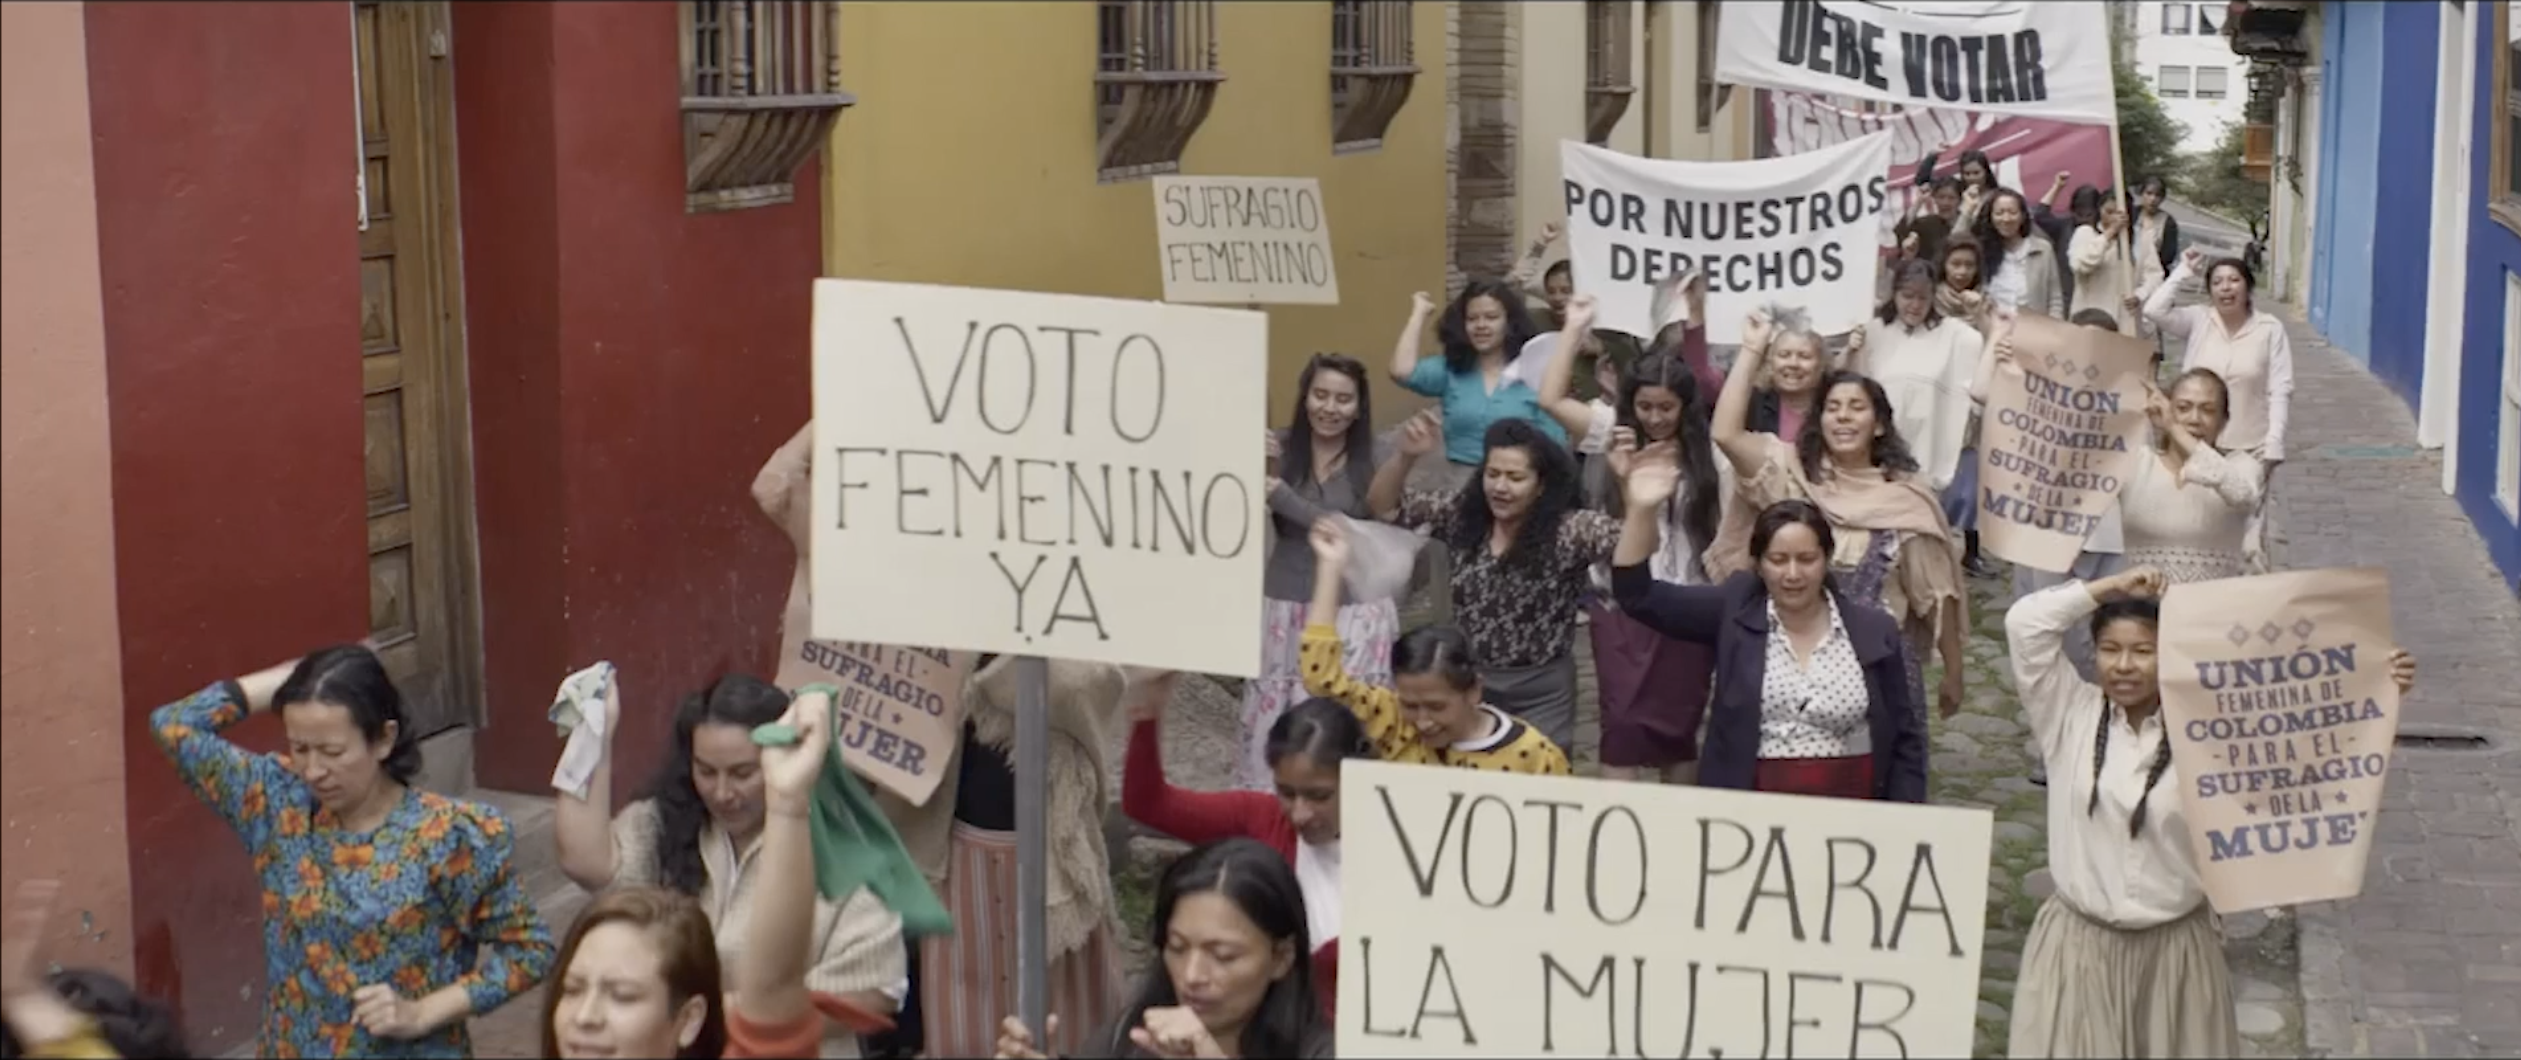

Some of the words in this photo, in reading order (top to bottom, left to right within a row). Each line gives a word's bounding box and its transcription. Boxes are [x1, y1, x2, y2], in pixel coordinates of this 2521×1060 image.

[1778, 1, 1888, 91] DEBE
[1900, 28, 2047, 103] VOTAR
[1165, 184, 1318, 232] SUFRAGIO
[1564, 178, 1647, 234] POR
[1664, 176, 1886, 241] NUESTROS
[1167, 241, 1328, 287] FEMENINO
[893, 316, 1164, 442] VOTO
[2023, 370, 2121, 416] UNIÓN
[1998, 408, 2127, 452] COLOMBIA
[2026, 397, 2083, 430] FEMENINA
[2088, 415, 2105, 431] DE
[1988, 449, 2118, 494] SUFRAGIO
[836, 447, 1249, 559] FEMENINO
[989, 551, 1110, 640] YA
[801, 640, 944, 716] SUFRAGIO
[2195, 643, 2356, 690] UNIÓN
[2185, 698, 2384, 742] COLOMBIA
[2216, 683, 2313, 714] FEMENINA
[2321, 679, 2343, 701] DE
[2197, 753, 2384, 798] SUFRAGIO
[2269, 794, 2292, 817] DE
[2300, 790, 2322, 813] LA
[2206, 811, 2367, 861] MUJE
[1375, 785, 1647, 925] VOTO
[1694, 816, 1964, 957] PARA
[1361, 936, 1478, 1045] LA
